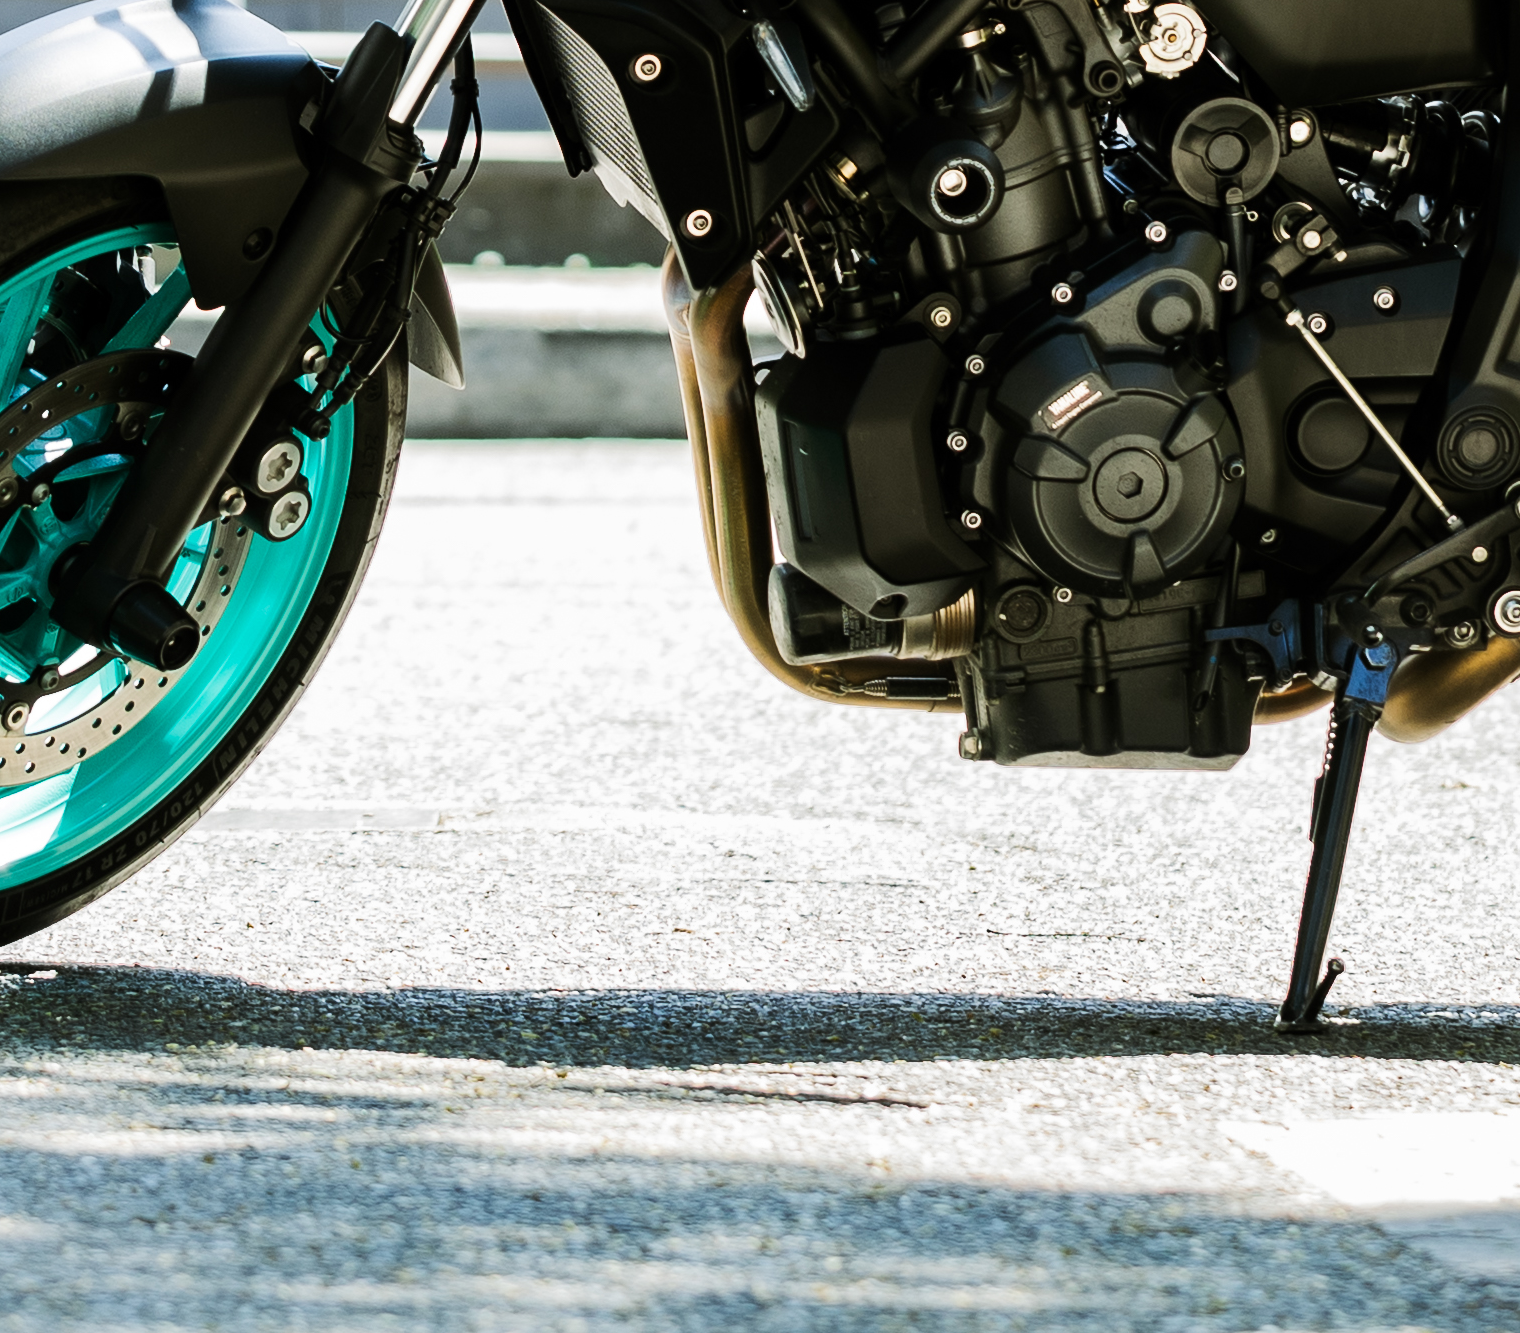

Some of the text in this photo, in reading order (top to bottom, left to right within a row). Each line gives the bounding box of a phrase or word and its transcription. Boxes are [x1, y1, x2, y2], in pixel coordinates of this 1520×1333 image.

[217, 615, 325, 767] MICHELIN
[135, 784, 204, 847] 120/70
[72, 866, 94, 889] 17
[100, 843, 127, 871] ZR
